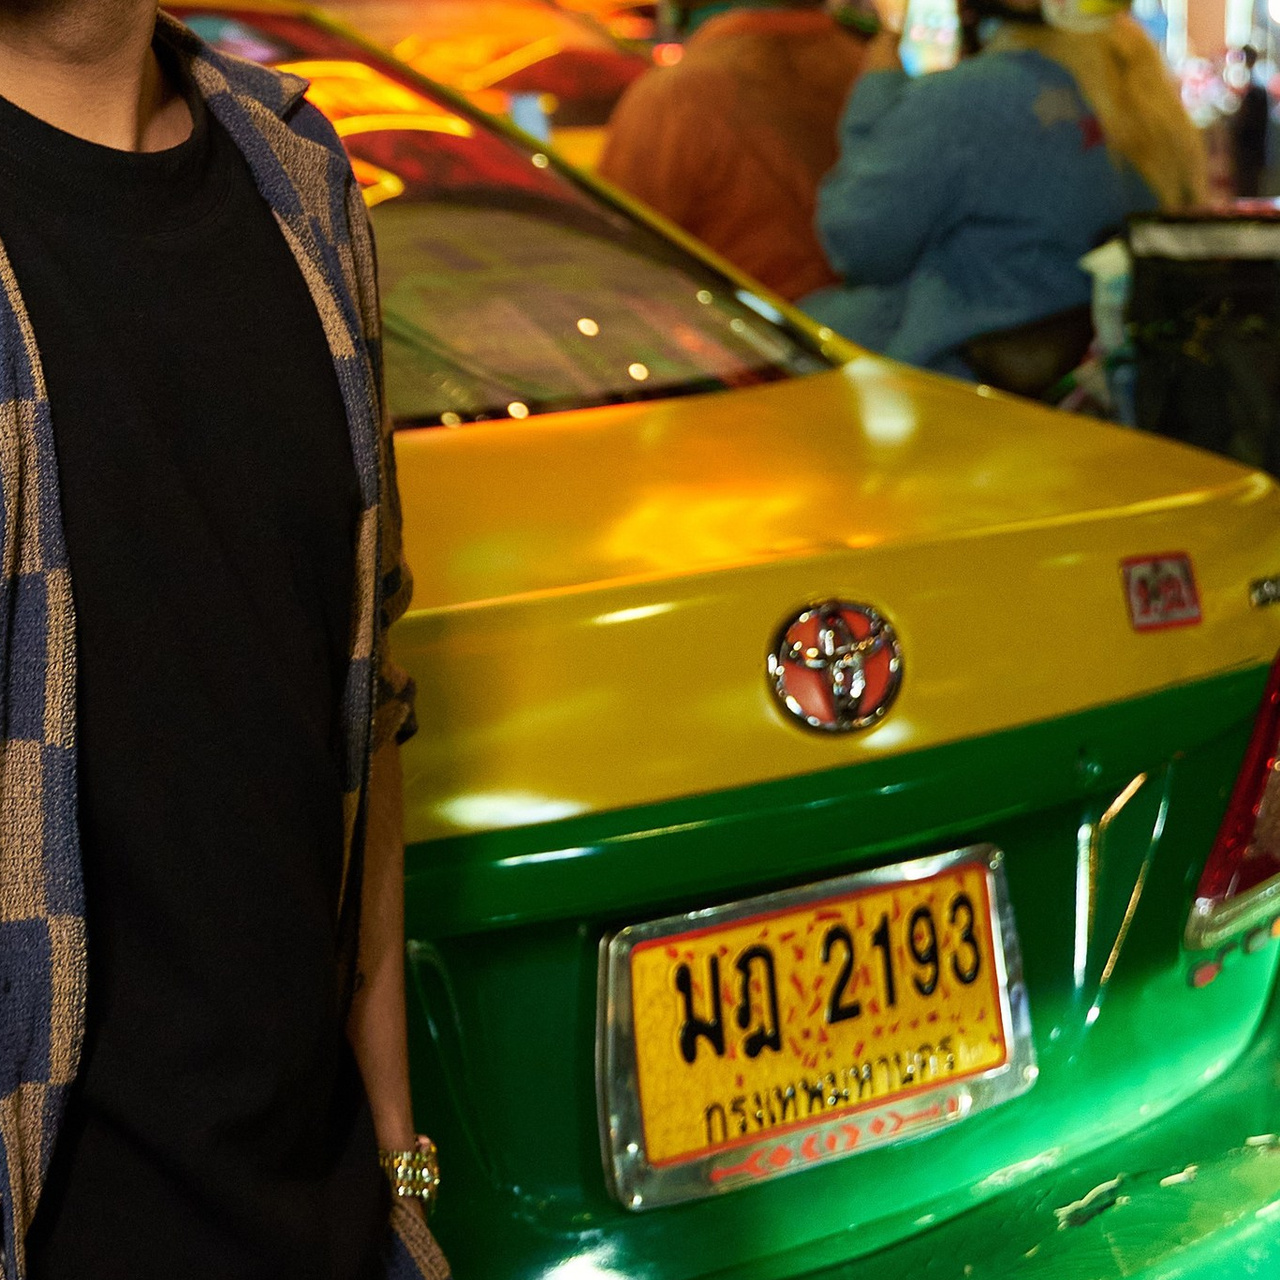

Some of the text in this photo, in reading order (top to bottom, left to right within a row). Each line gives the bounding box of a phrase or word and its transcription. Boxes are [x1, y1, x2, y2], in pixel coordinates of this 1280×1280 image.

[821, 893, 983, 1025] 2193
[703, 1036, 955, 1145] กรงเทพมหานคร
